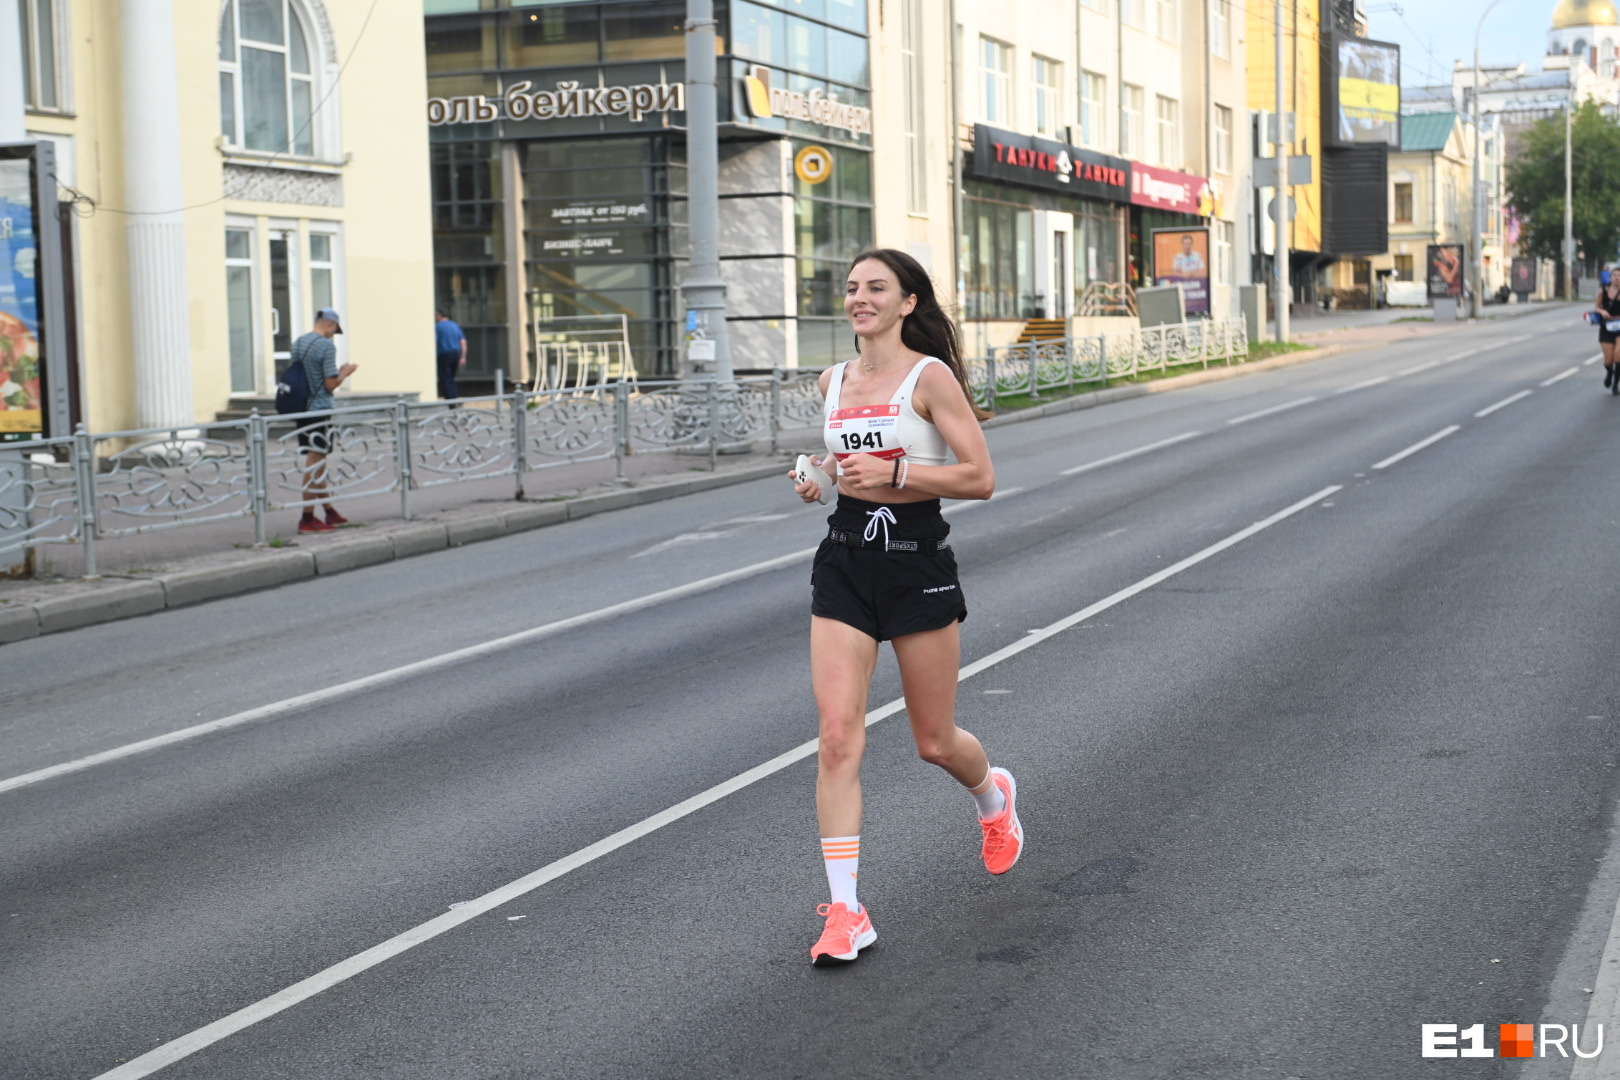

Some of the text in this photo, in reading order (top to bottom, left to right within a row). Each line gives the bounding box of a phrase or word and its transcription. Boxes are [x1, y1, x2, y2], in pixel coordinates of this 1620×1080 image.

[506, 81, 684, 121] бейкери
[809, 87, 872, 139] бейкери
[994, 142, 1126, 187] ТАНУКИ ТАНУКИ
[841, 431, 884, 450] 1941
